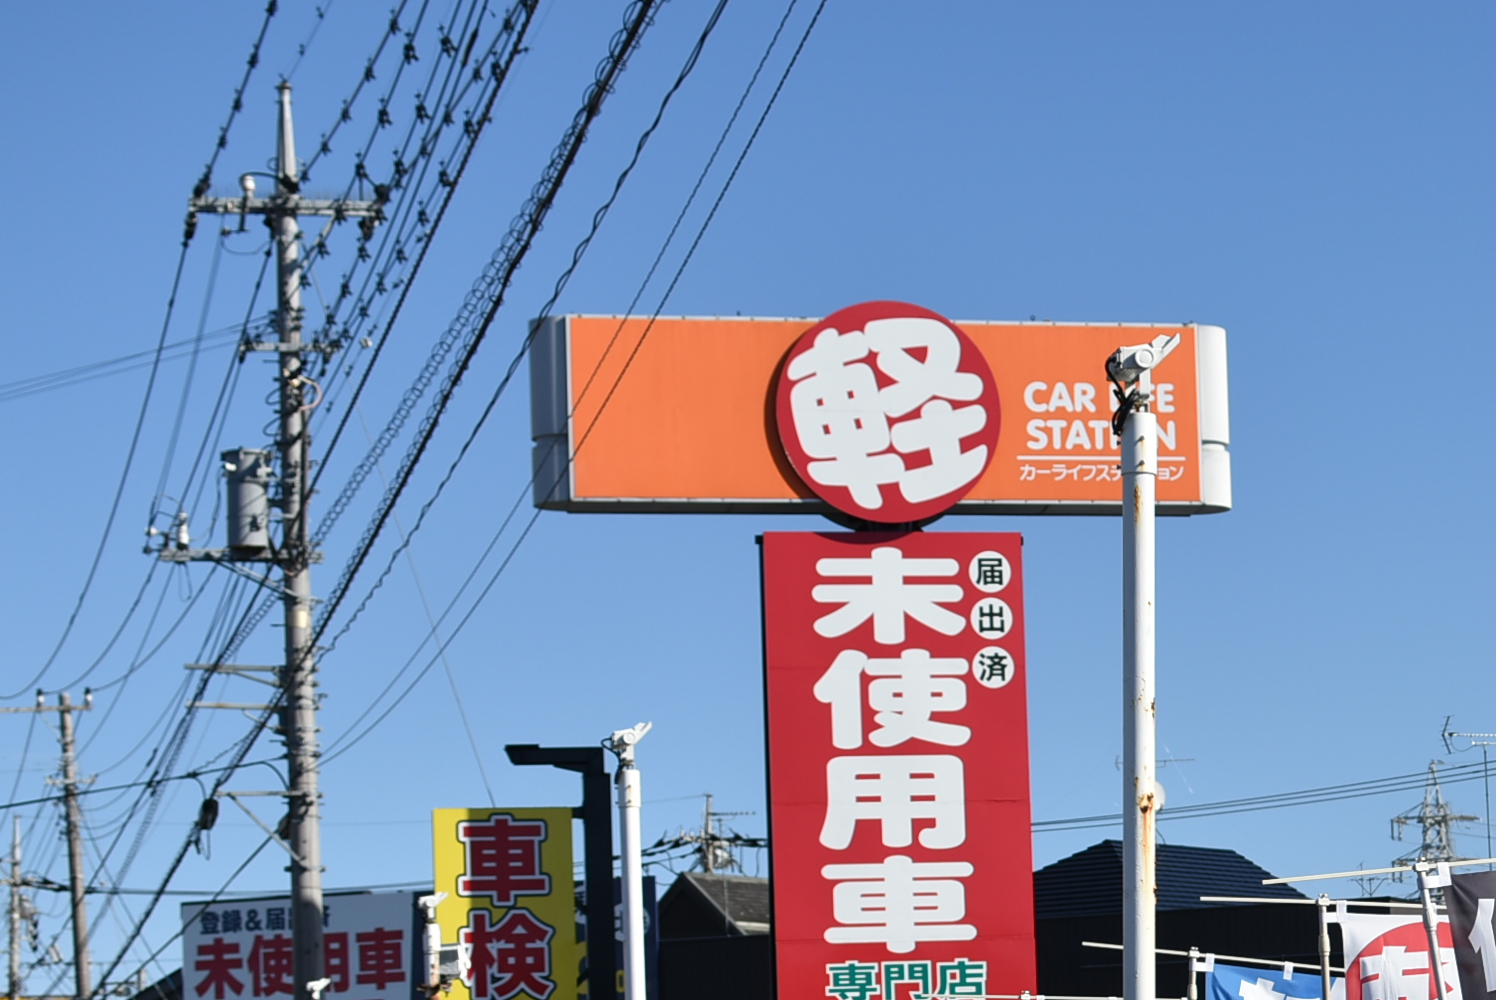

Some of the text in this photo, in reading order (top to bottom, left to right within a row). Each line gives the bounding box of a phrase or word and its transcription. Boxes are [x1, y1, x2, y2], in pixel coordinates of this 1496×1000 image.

[787, 318, 988, 509] 軽
[1024, 381, 1096, 412] CAR
[1026, 419, 1176, 450] STATIN
[975, 556, 1009, 684] 届出済
[811, 547, 978, 953] 未使用車
[200, 906, 331, 935] 登録&届
